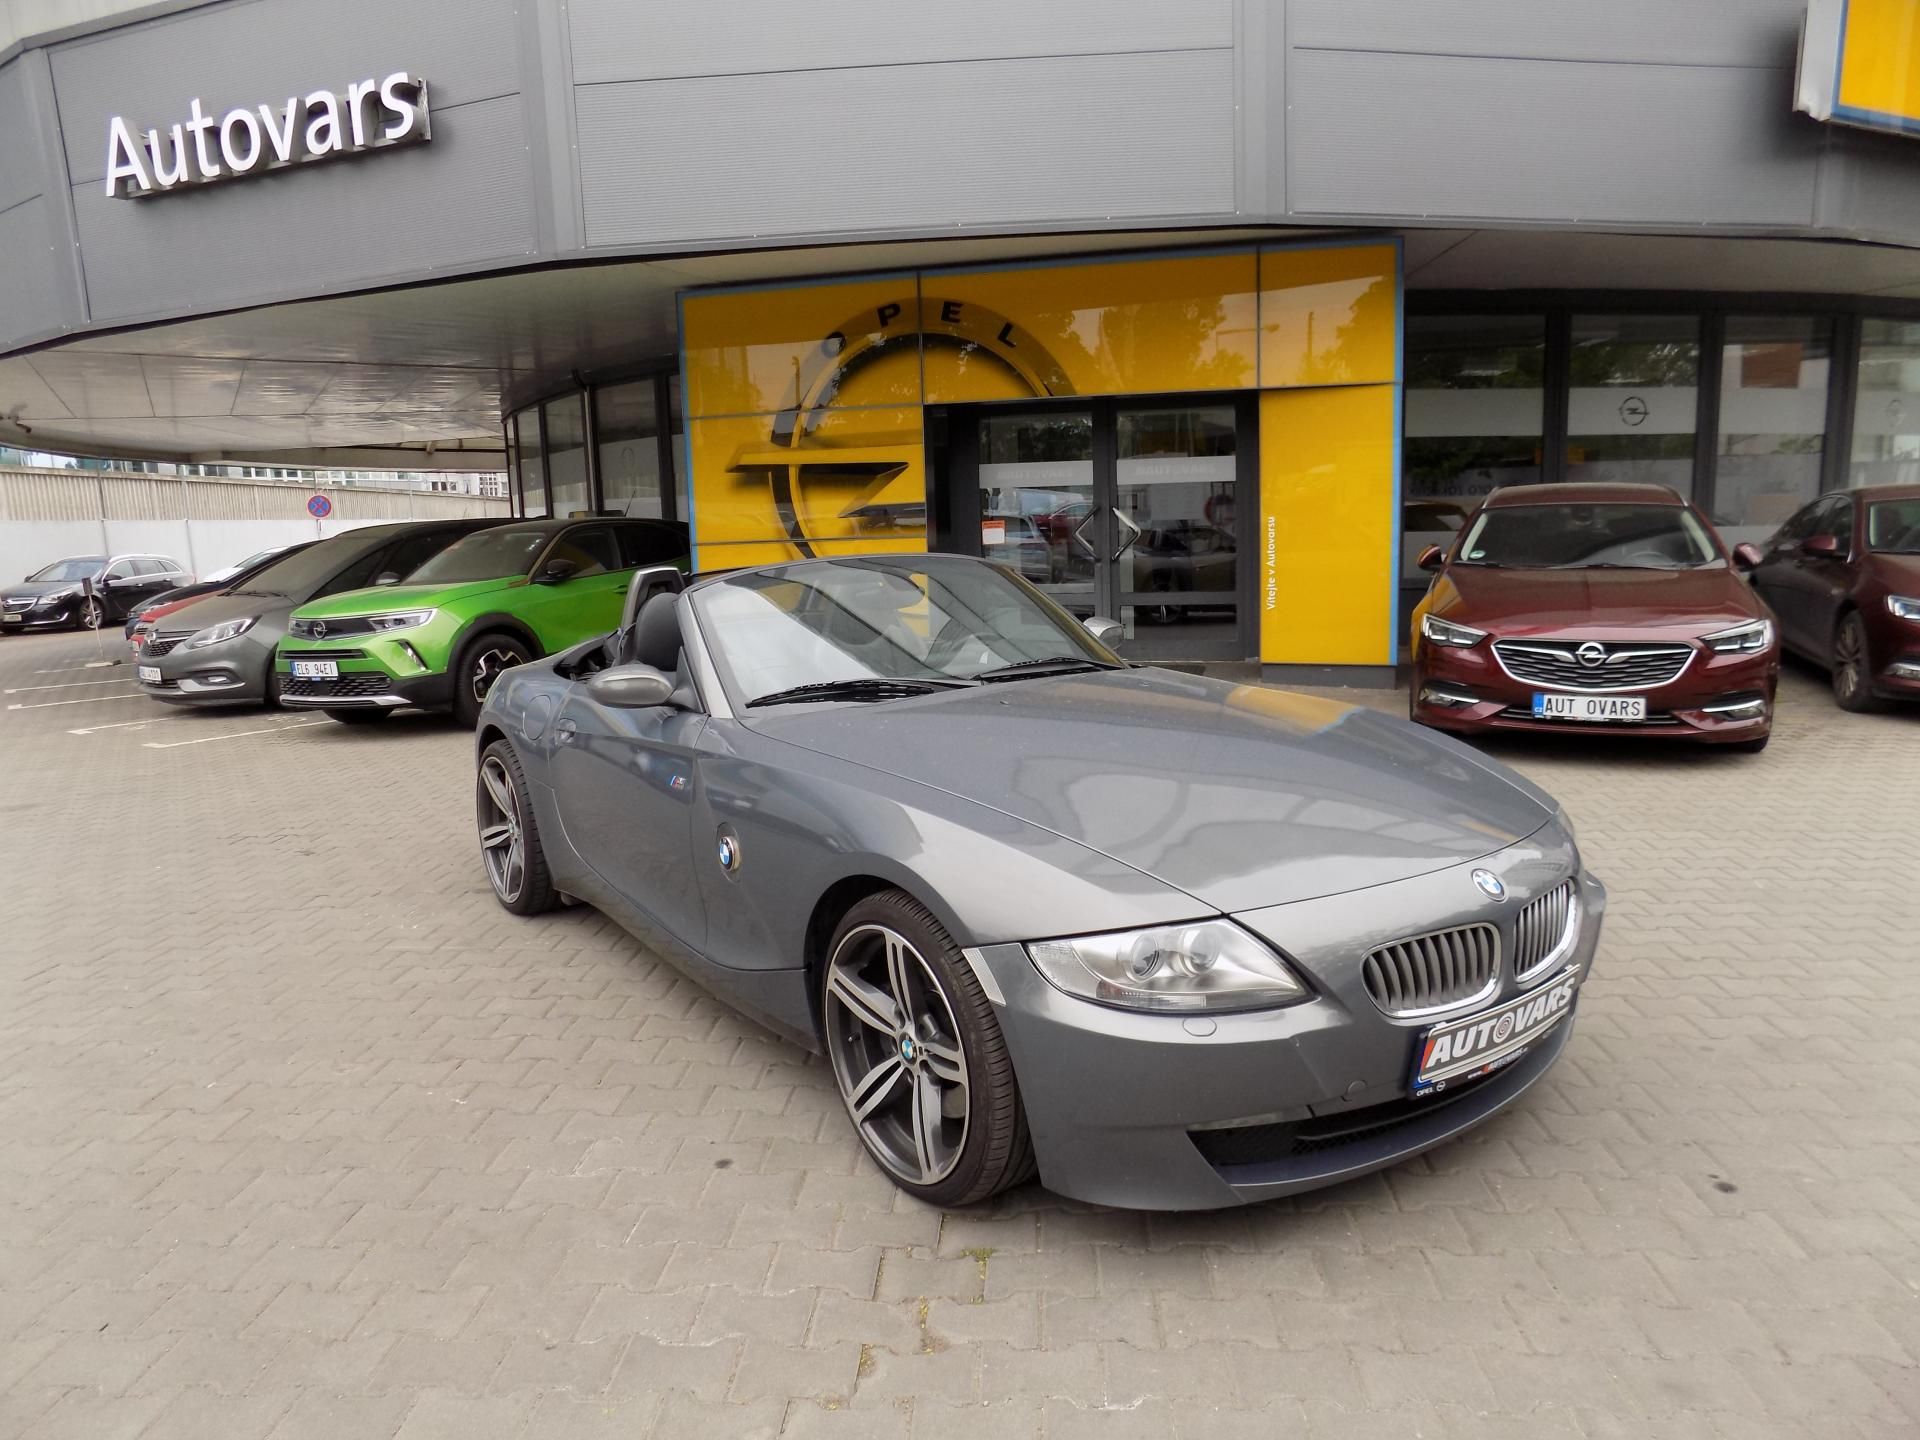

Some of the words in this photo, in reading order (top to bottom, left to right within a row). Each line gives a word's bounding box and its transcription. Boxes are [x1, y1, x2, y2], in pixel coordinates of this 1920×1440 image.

[105, 71, 416, 198] Autovars
[822, 300, 1017, 357] OPEL
[1265, 516, 1276, 567] Autovarsu
[296, 663, 310, 675] EL6
[1545, 698, 1575, 714] AUT
[1586, 699, 1641, 716] OVARS
[1425, 977, 1575, 1068] AUTOVARS
